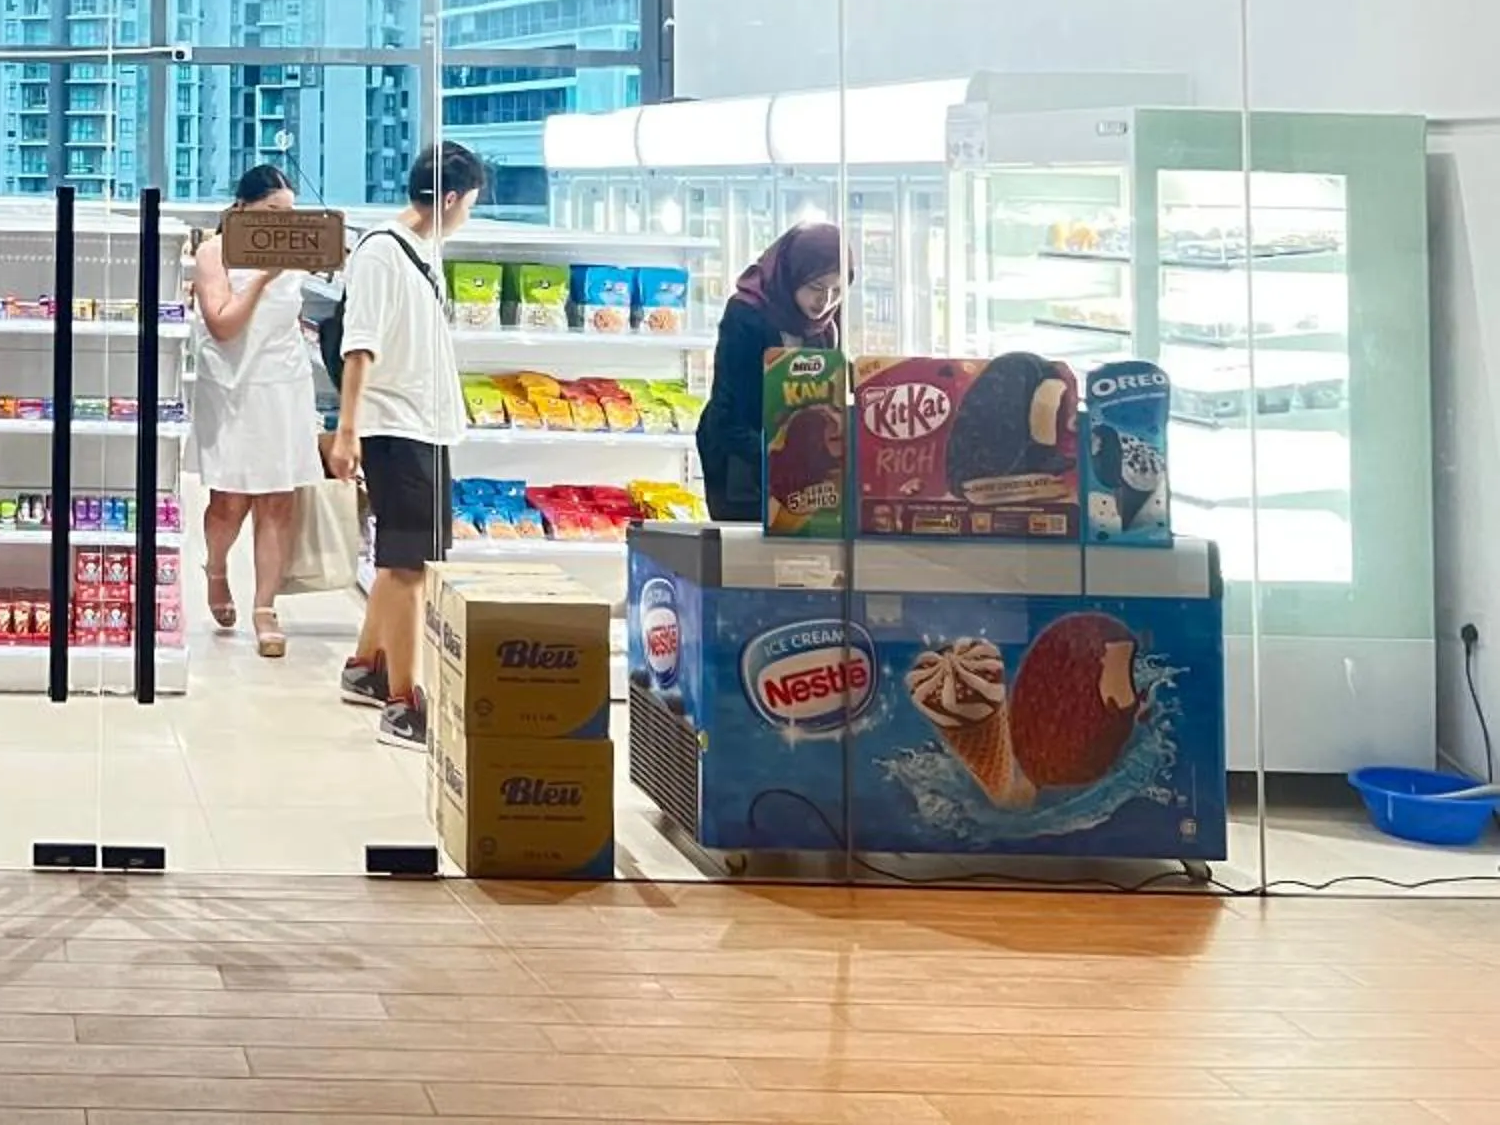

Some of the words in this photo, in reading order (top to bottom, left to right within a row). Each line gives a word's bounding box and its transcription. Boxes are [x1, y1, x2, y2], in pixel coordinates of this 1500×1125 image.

[251, 228, 319, 250] OPEN
[792, 358, 822, 373] MILO
[782, 381, 830, 405] KAW
[1091, 373, 1166, 397] OREO
[873, 385, 946, 438] KitKat
[497, 639, 579, 670] Bleu
[762, 640, 788, 658] ICE
[500, 776, 583, 806] Bleu
